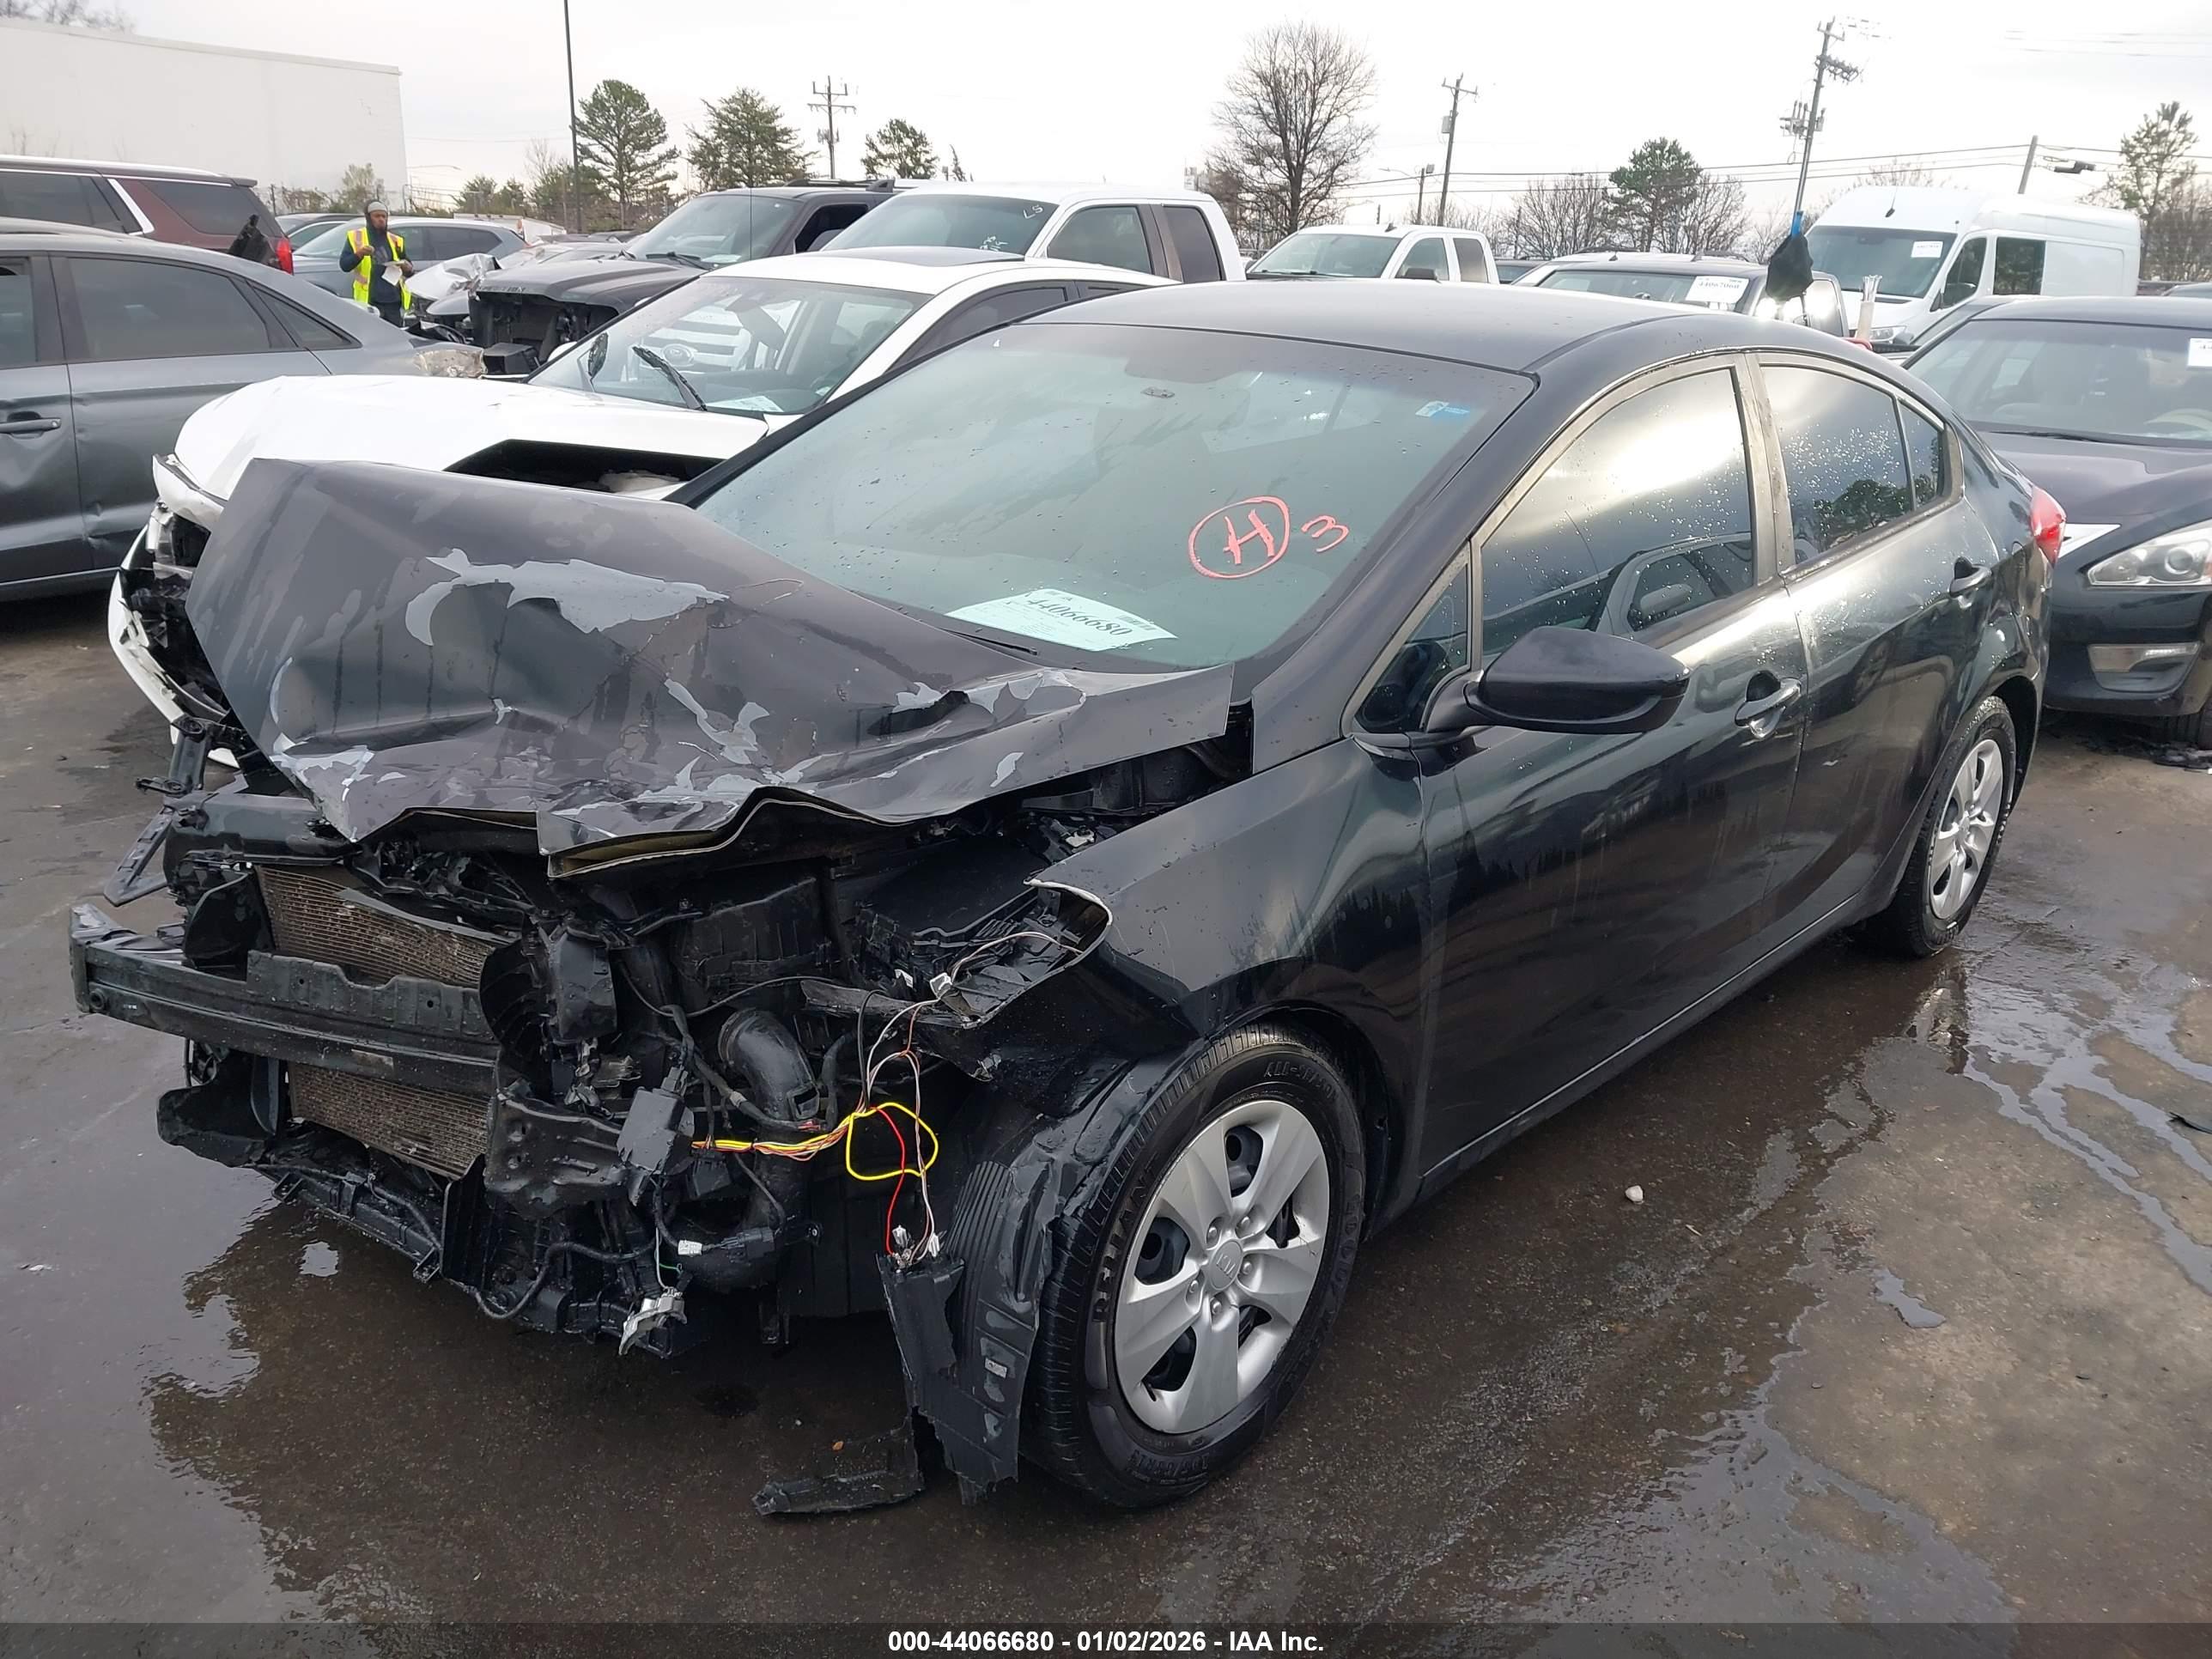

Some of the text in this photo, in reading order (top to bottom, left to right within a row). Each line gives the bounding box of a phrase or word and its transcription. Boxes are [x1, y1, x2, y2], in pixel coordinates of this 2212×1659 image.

[1223, 508, 1350, 565] H 3
[1027, 599, 1133, 636] 44066680
